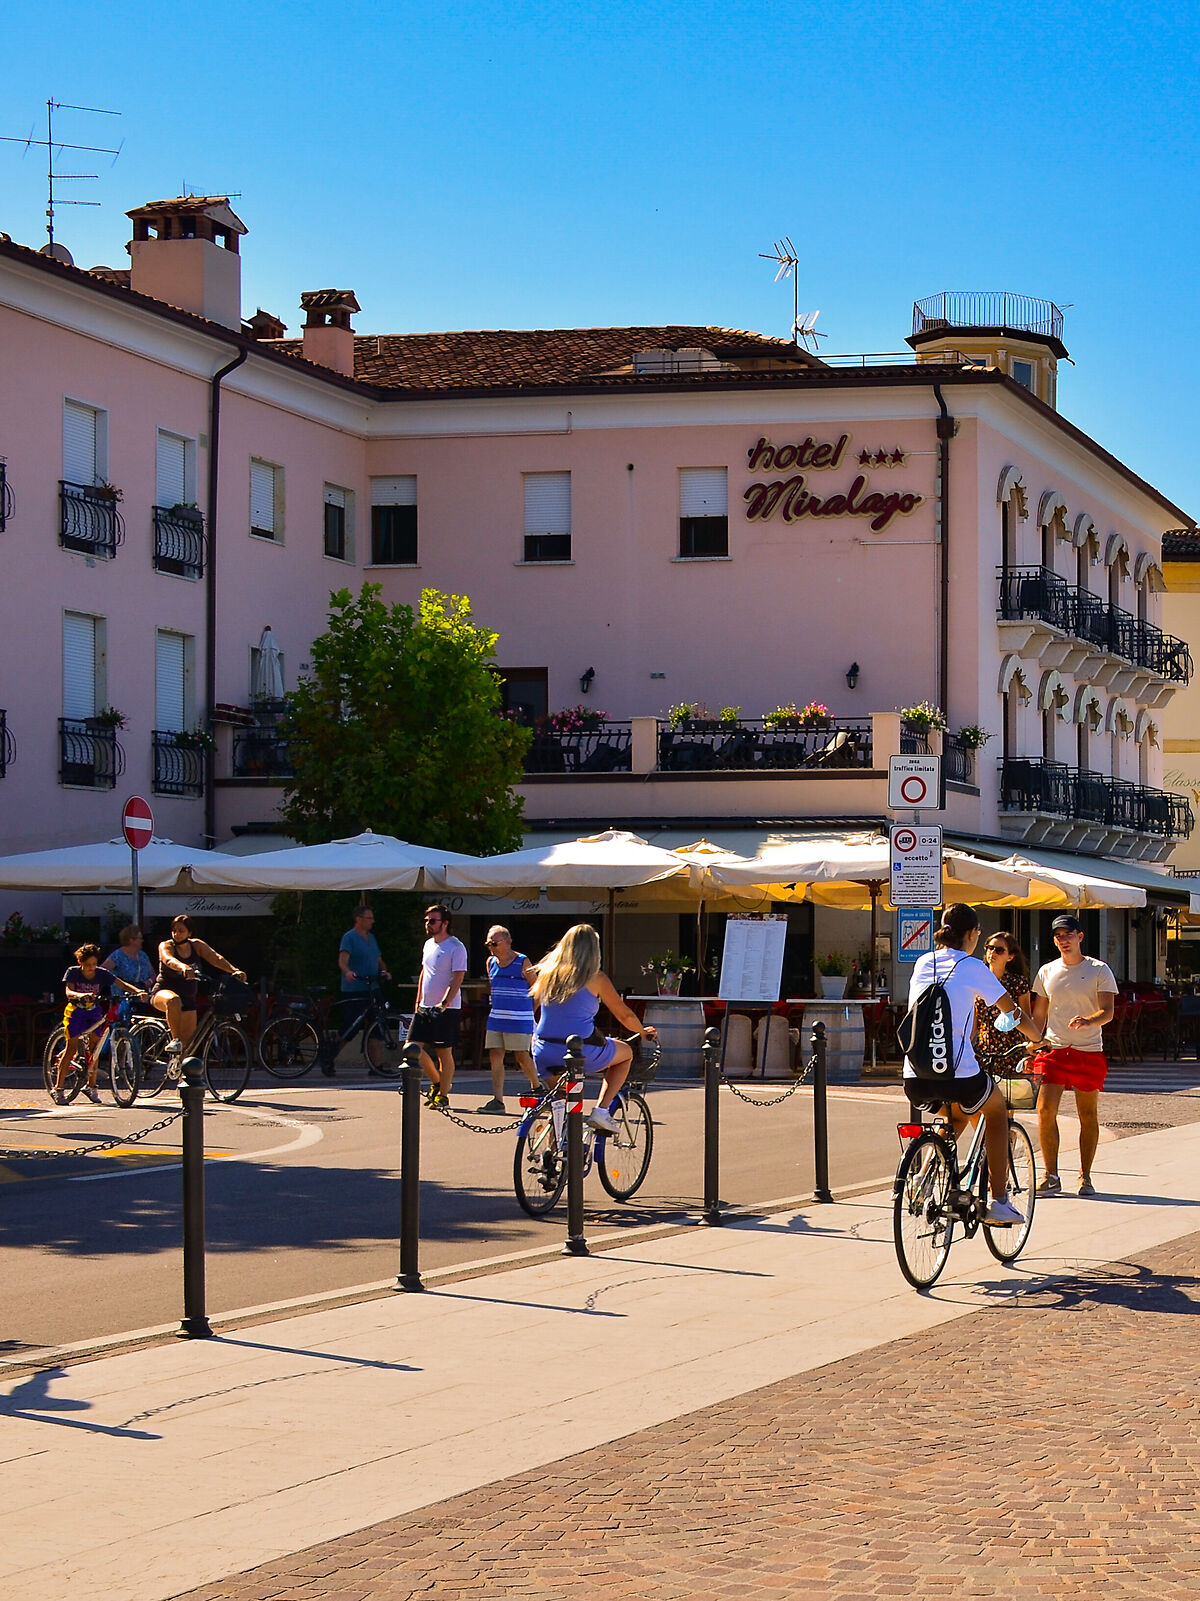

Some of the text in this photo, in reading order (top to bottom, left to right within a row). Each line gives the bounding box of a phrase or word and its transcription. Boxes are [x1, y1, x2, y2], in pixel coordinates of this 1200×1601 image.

[747, 433, 850, 472] hotel
[743, 473, 925, 534] Miralago
[185, 896, 242, 911] Ristorante
